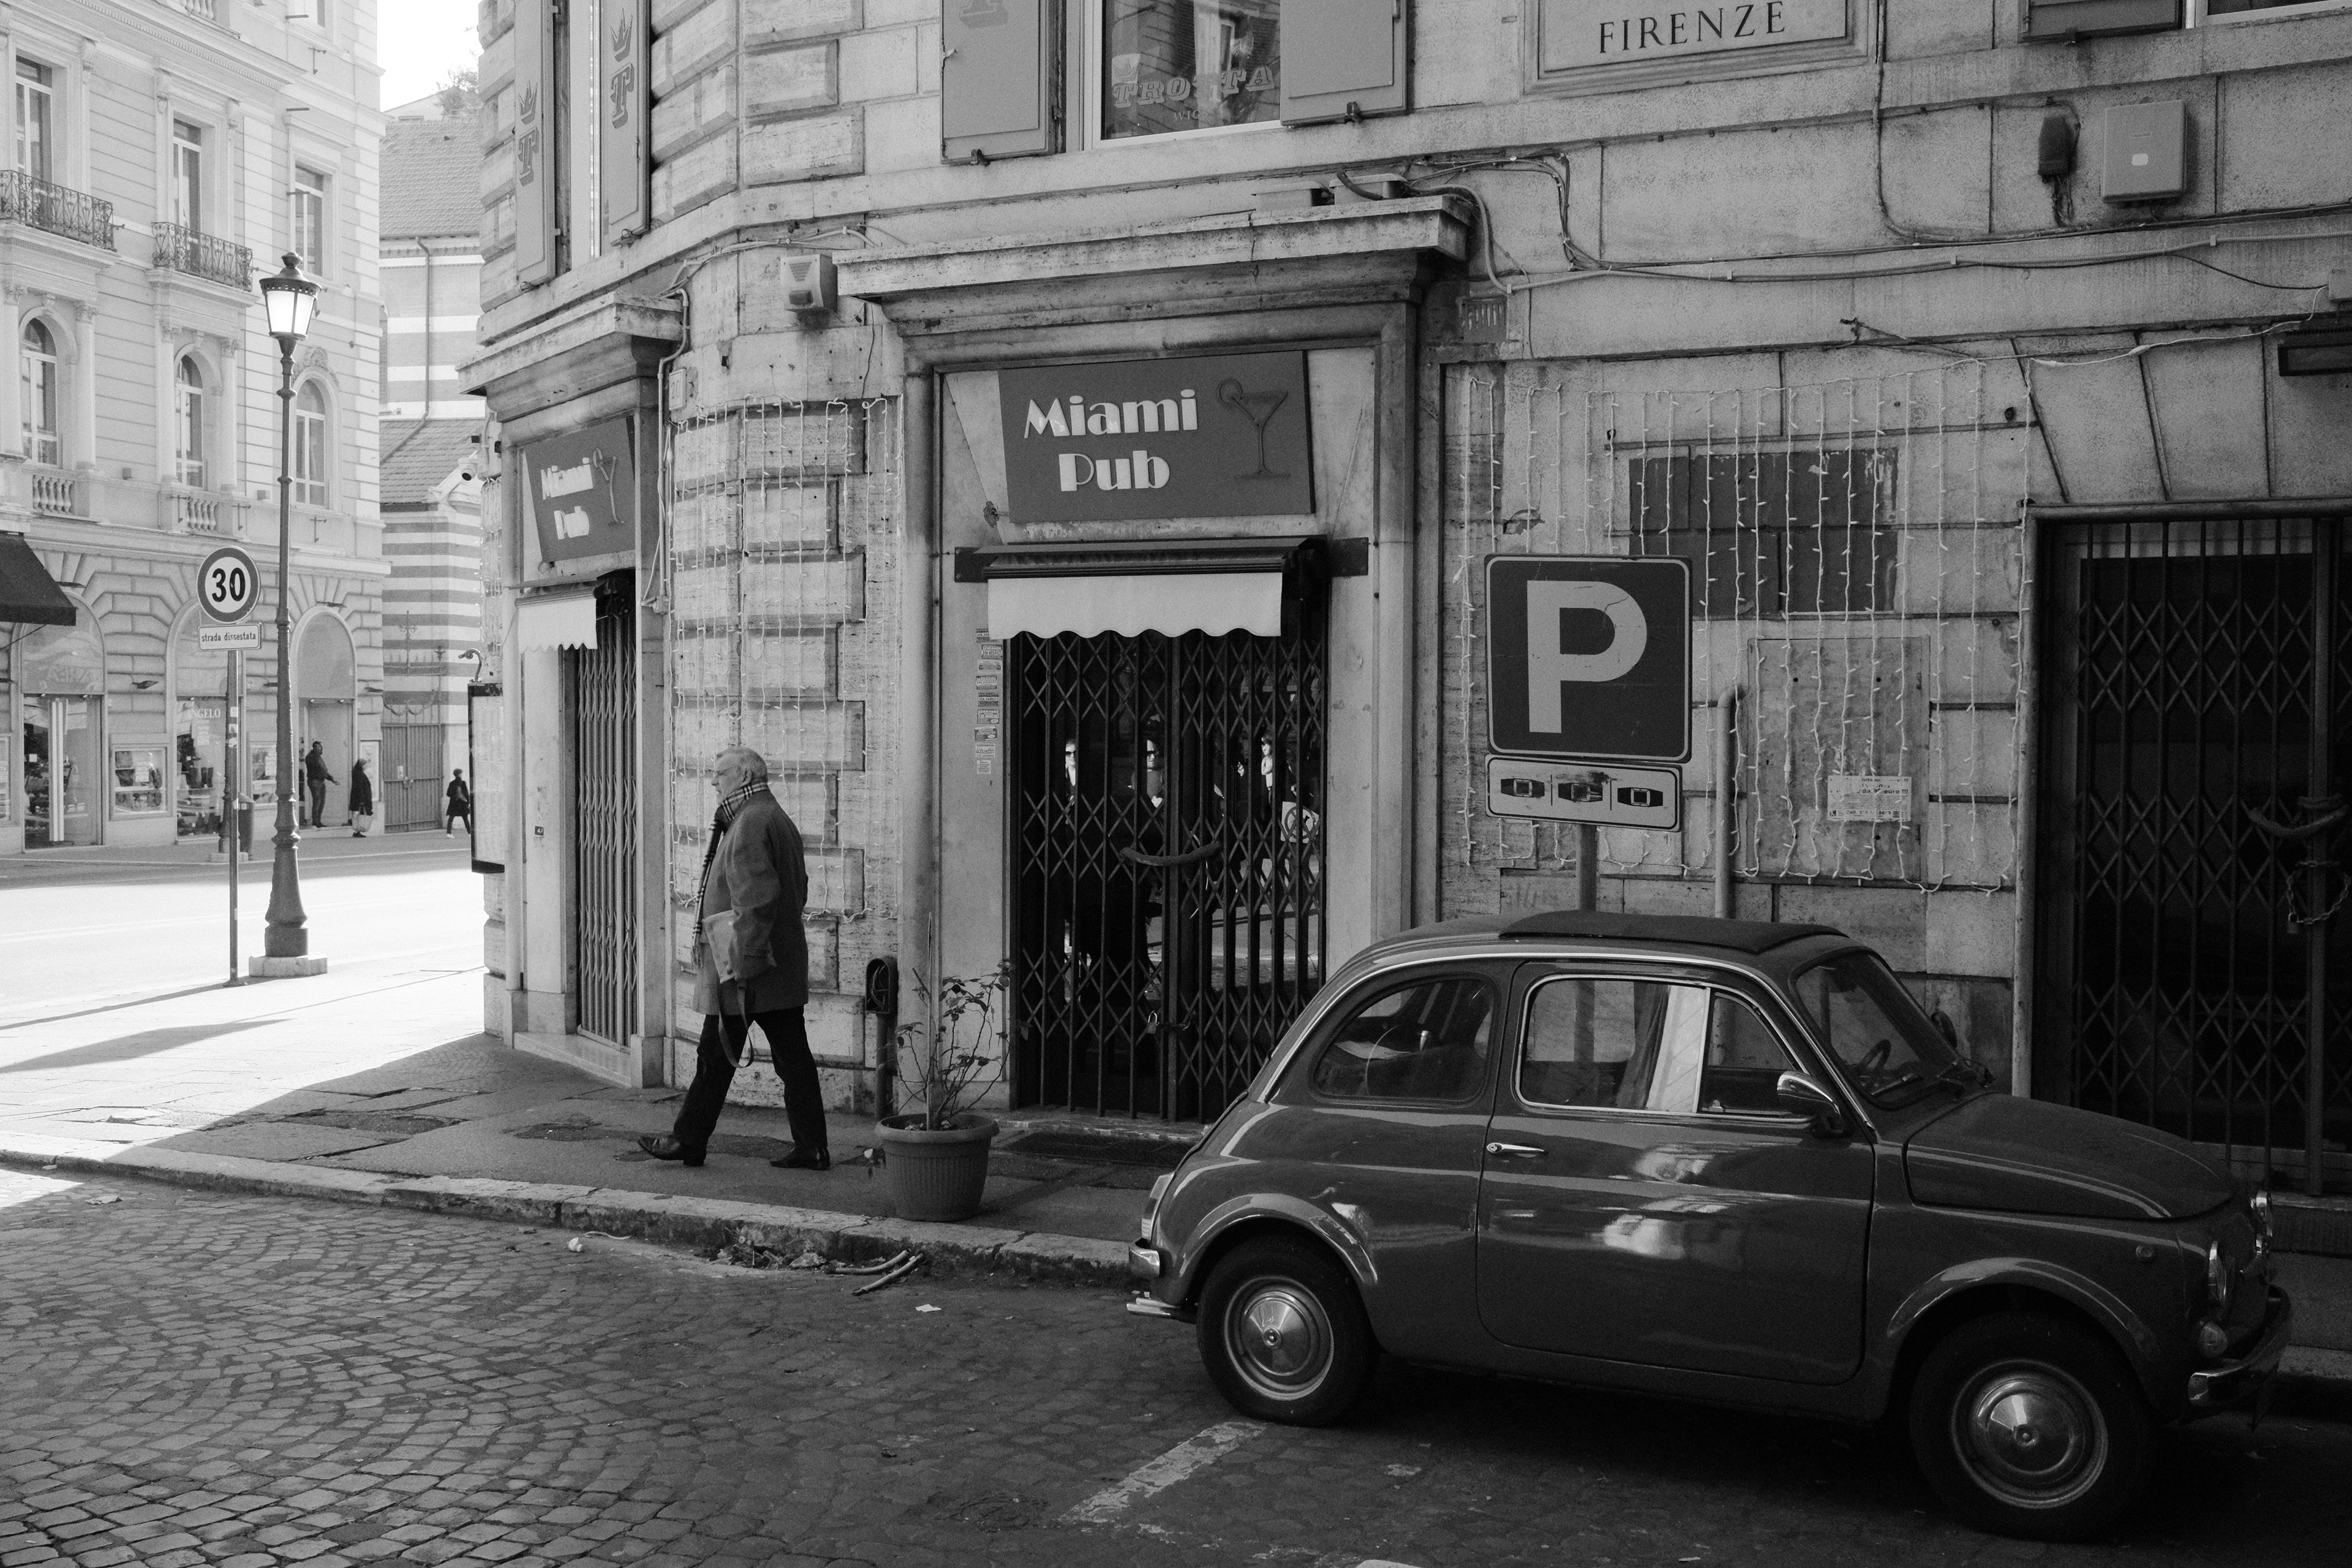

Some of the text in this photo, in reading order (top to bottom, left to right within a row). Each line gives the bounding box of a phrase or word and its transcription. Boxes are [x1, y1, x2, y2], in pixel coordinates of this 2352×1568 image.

[1599, 1, 1787, 53] FIRENZE
[1024, 389, 1199, 439] Miami
[541, 457, 594, 500] Miami
[1058, 450, 1170, 492] Pub
[554, 505, 590, 540] Pub
[211, 567, 246, 603] 30
[202, 631, 256, 642] strada dissestata
[1526, 579, 1648, 734] P
